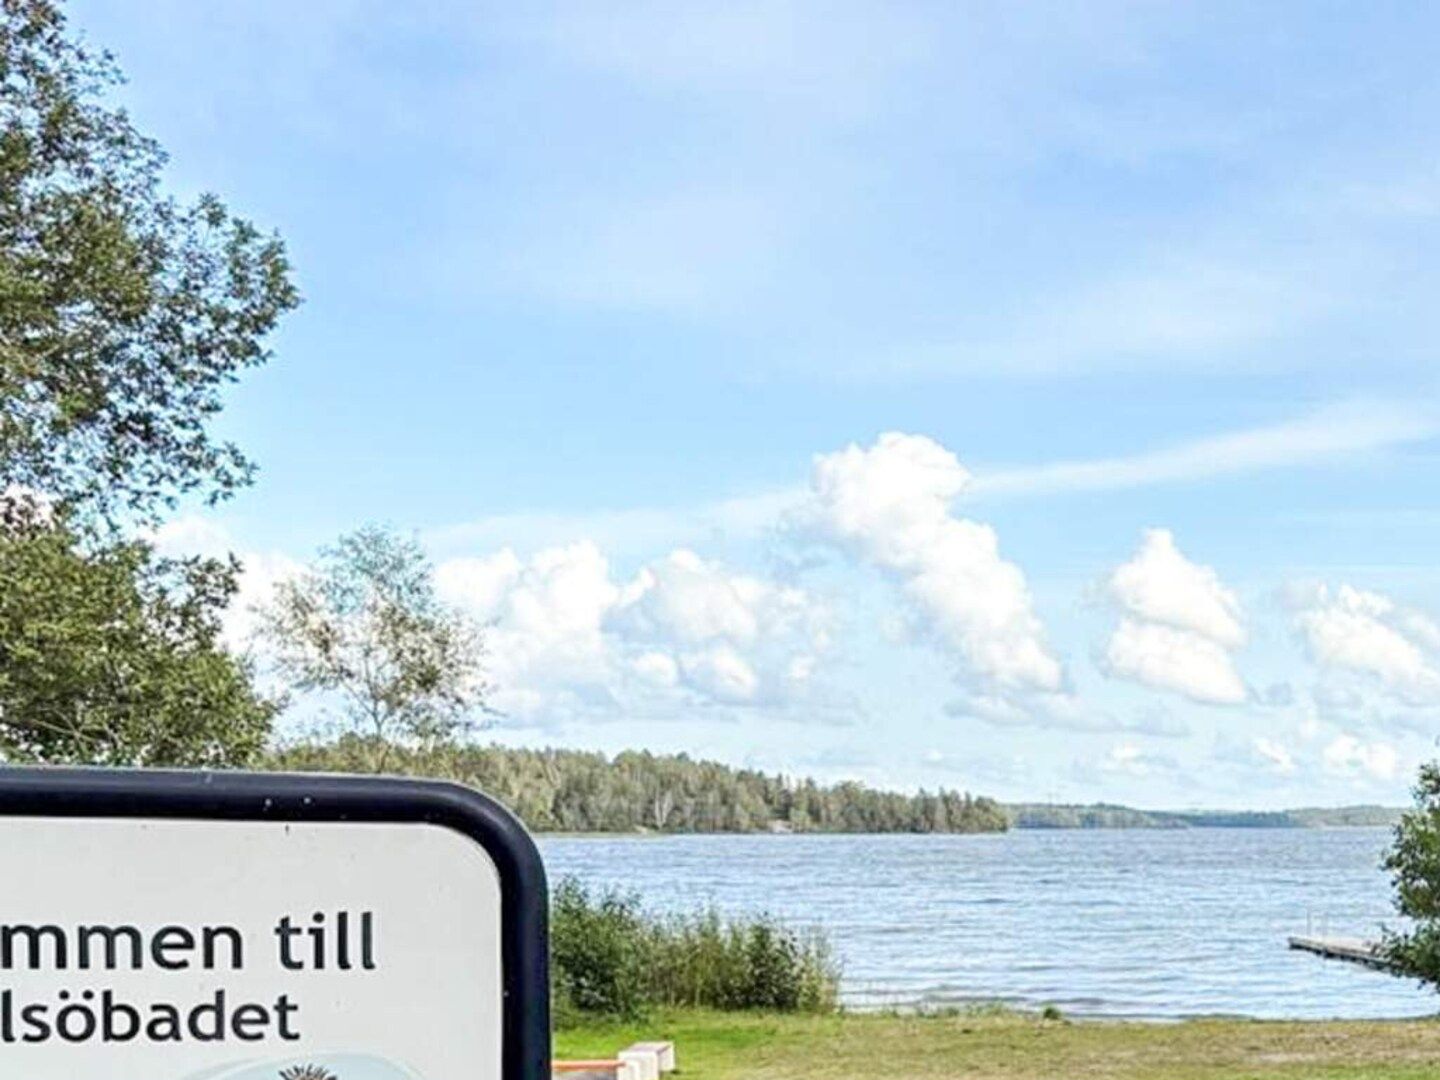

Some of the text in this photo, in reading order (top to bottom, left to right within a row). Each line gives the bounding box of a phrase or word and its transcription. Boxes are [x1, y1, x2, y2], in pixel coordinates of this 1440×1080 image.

[0, 911, 376, 970] mmen till
[1, 989, 301, 1043] lsöbadet
